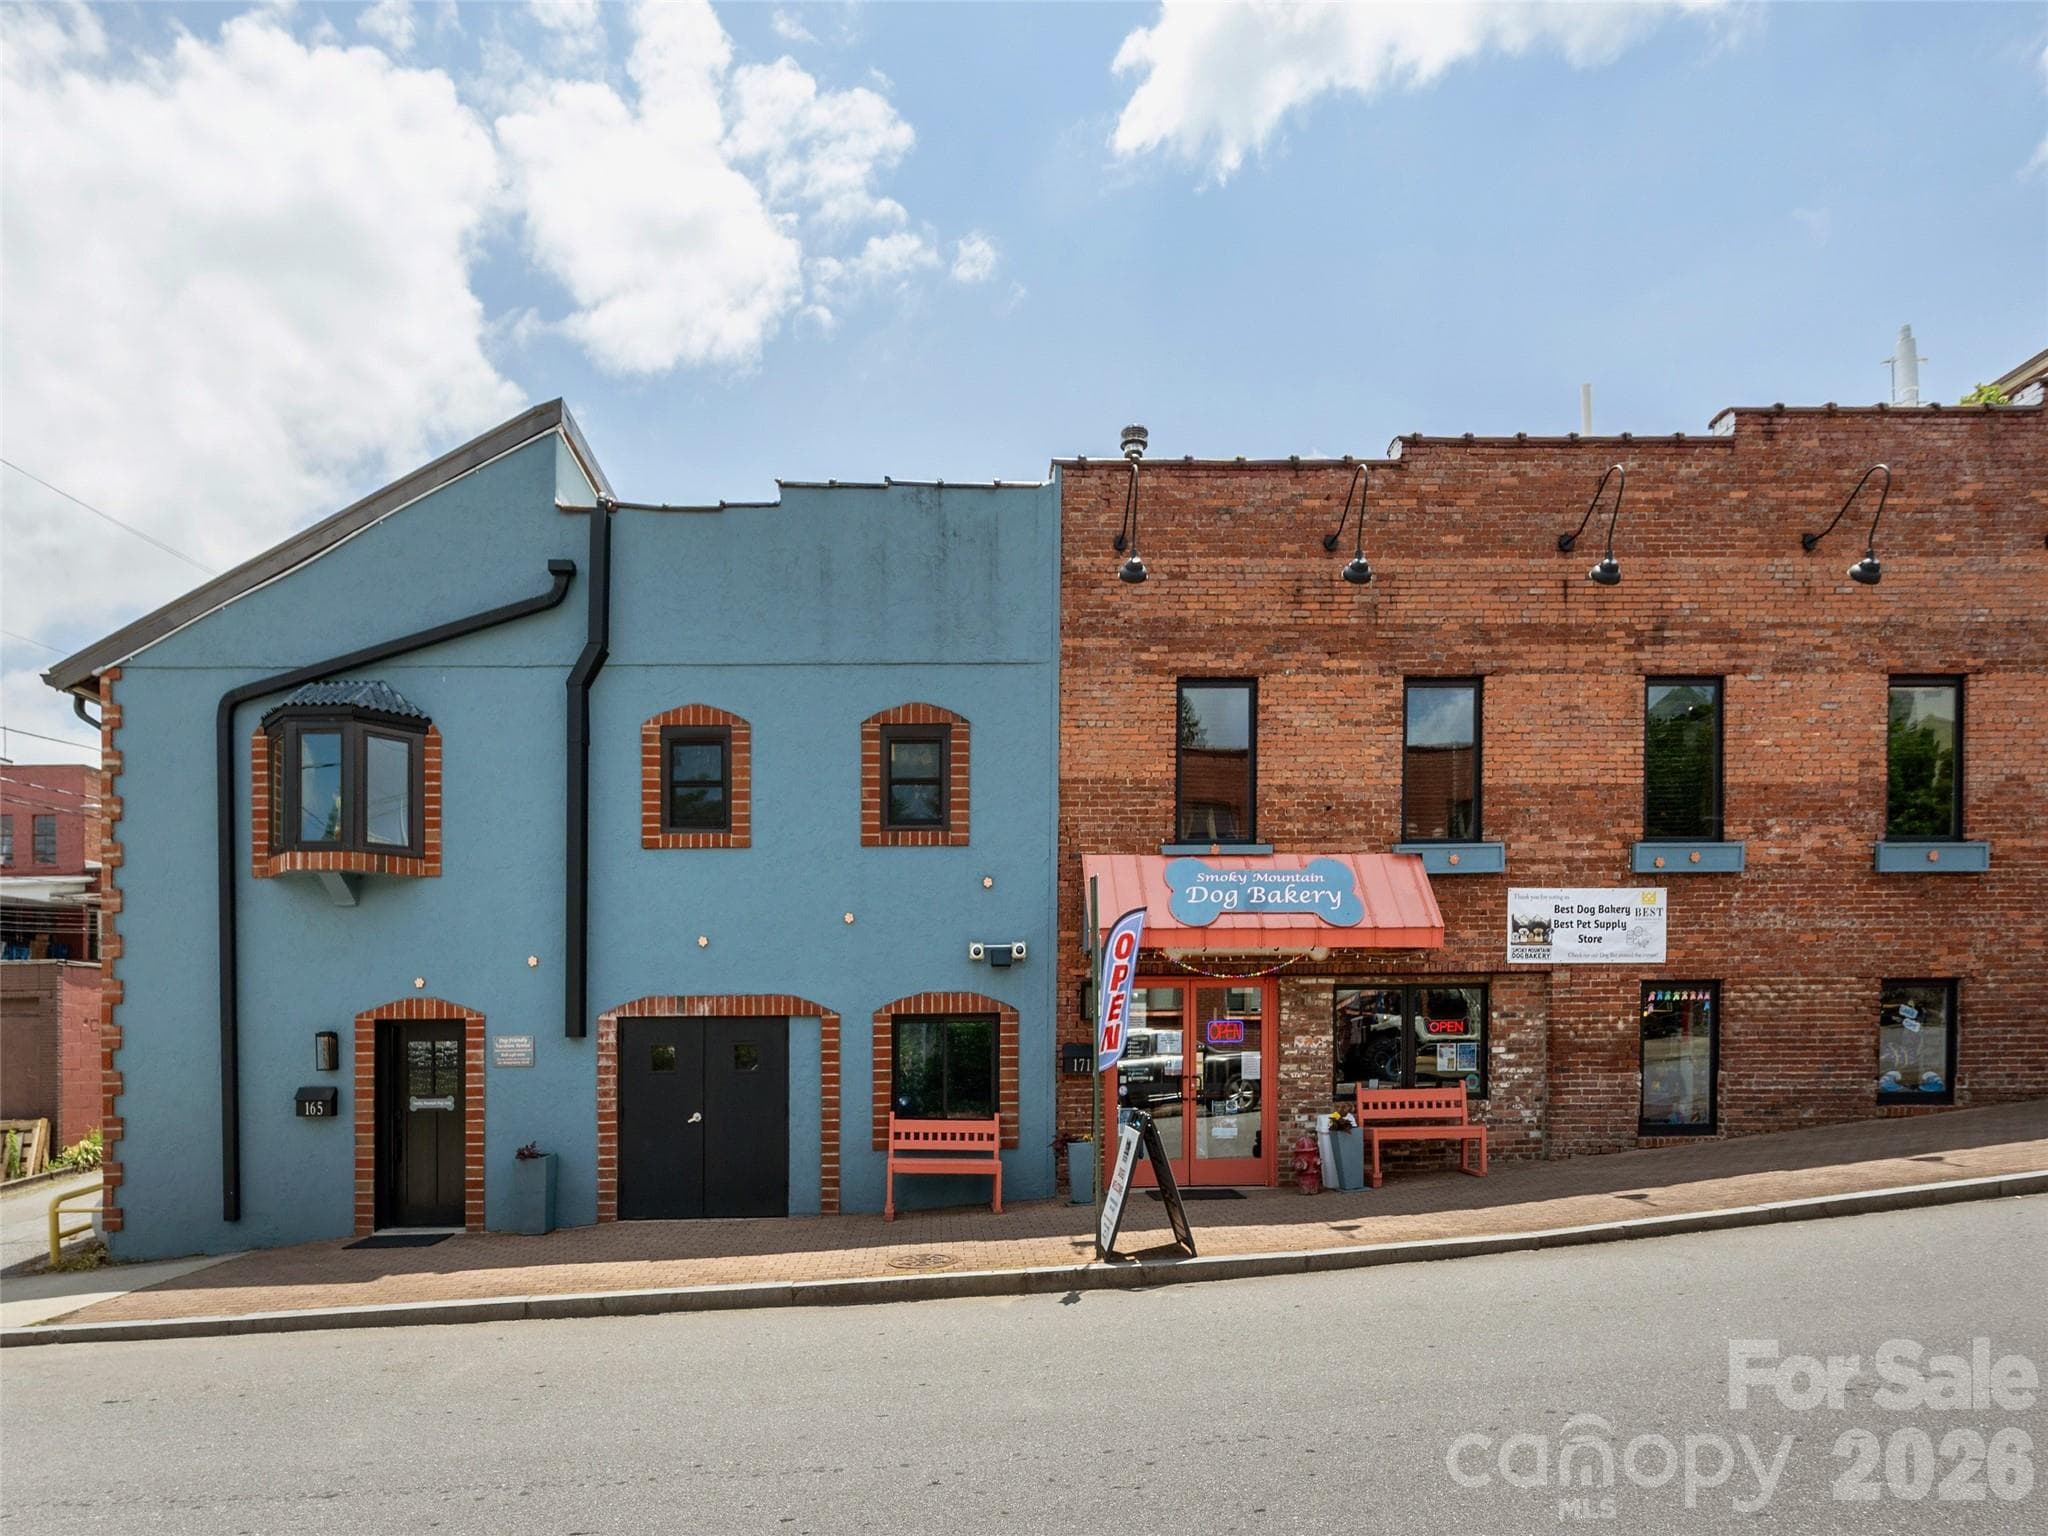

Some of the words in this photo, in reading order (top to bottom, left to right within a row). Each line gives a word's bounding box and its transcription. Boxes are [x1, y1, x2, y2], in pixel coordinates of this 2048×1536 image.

[1196, 871, 1248, 885] Smoky
[1252, 871, 1324, 883] Mountain
[1186, 885, 1239, 909] Dog
[1248, 885, 1342, 910] Bakery
[1554, 904, 1574, 914] Best
[1577, 904, 1595, 916] Dog
[1598, 904, 1631, 916] Bakery
[1635, 907, 1664, 917] BEST
[1553, 919, 1574, 929] Best
[1576, 919, 1591, 929] Pet
[1593, 919, 1627, 931] Supply
[1578, 934, 1603, 944] Store
[1100, 931, 1134, 1054] OPEN
[1210, 1022, 1243, 1040] OPEN
[1429, 1021, 1464, 1032] OPEN
[1073, 1058, 1090, 1072] 171
[305, 1101, 324, 1116] 165
